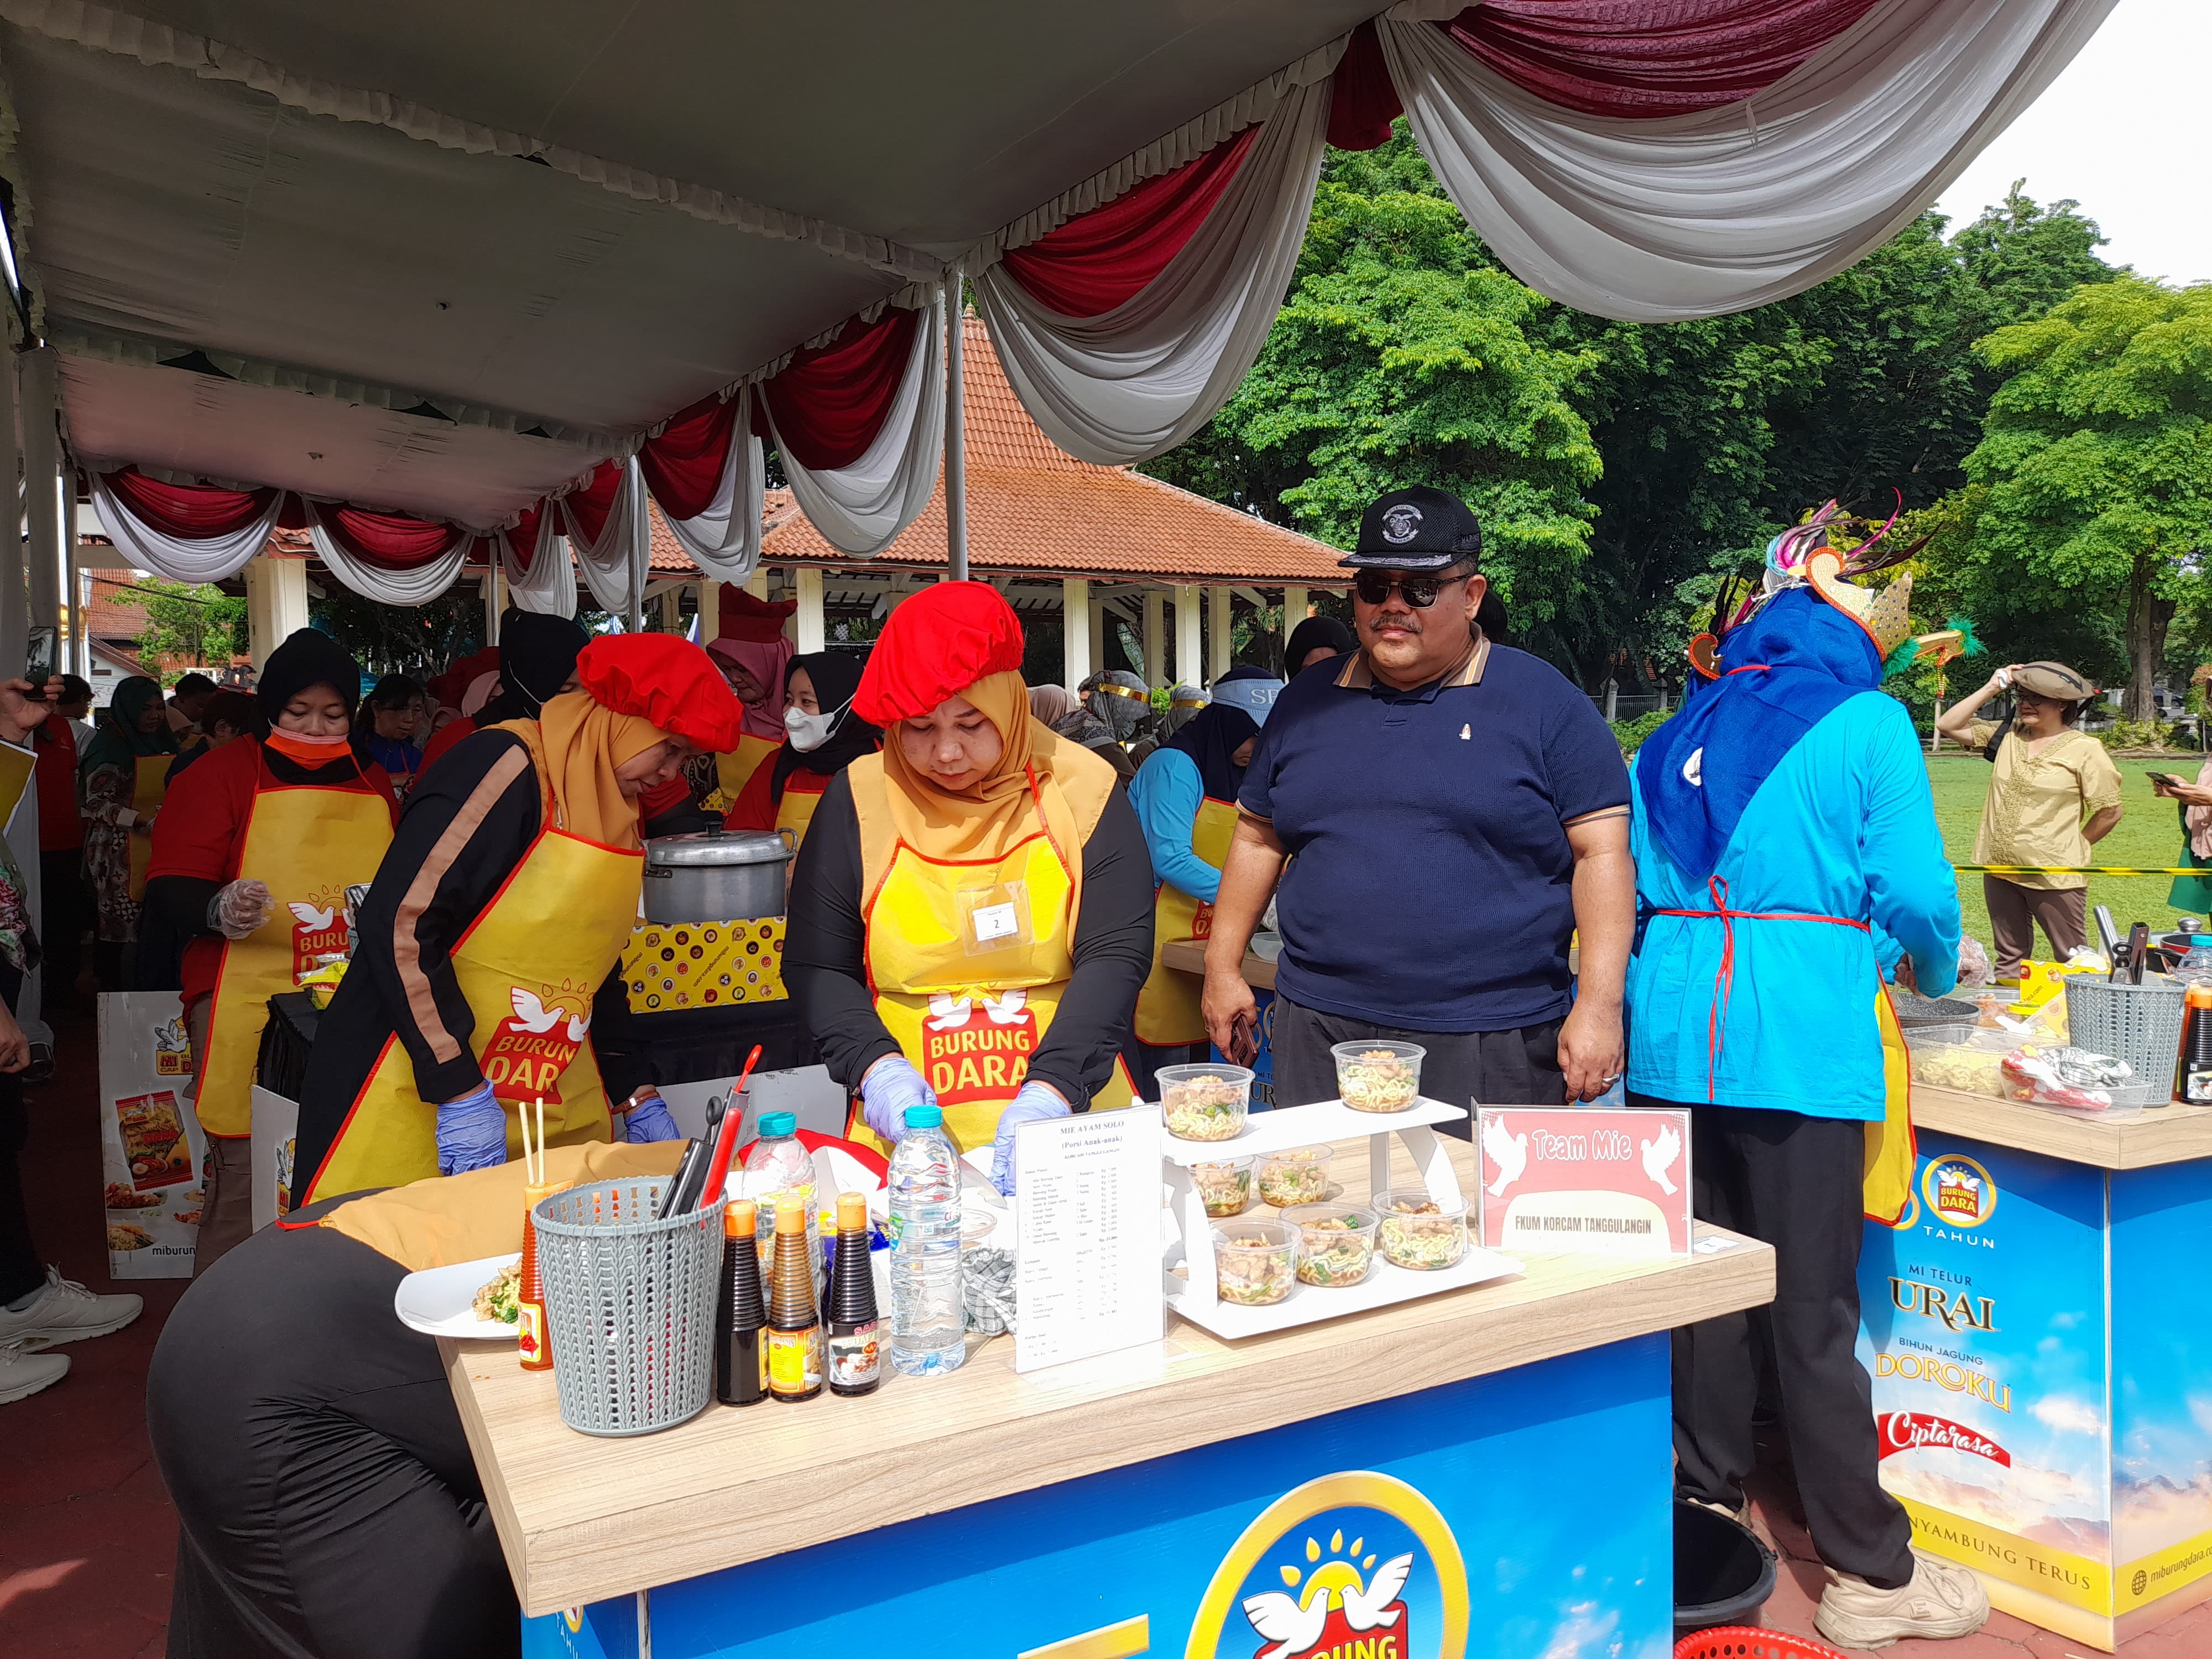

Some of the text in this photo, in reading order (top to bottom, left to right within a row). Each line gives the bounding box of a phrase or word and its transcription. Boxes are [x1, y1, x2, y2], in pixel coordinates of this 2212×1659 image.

[994, 919, 1000, 928] 2
[930, 1029, 1030, 1058] BURUNG
[932, 1055, 1029, 1095] DARA
[1060, 1120, 1124, 1134] MIE AYAM SOLO
[1062, 1135, 1123, 1149] (Porsi Anak-anak)
[1531, 1129, 1632, 1161] Team Mie
[1940, 1187, 1976, 1201] BURUNG
[1941, 1196, 1977, 1213] DARA
[1515, 1215, 1652, 1234] FKUM KORCAM TANGGULANGIN
[1923, 1225, 1995, 1249] TAHUN
[1909, 1264, 1973, 1287] MI TELUR
[1887, 1276, 1996, 1333] URAI
[1899, 1337, 1984, 1365] BIHUN JAGUNG
[1875, 1353, 2011, 1414] DOROKU
[1887, 1409, 2000, 1455] Ciptarasa
[2025, 1556, 2091, 1590] TERUS
